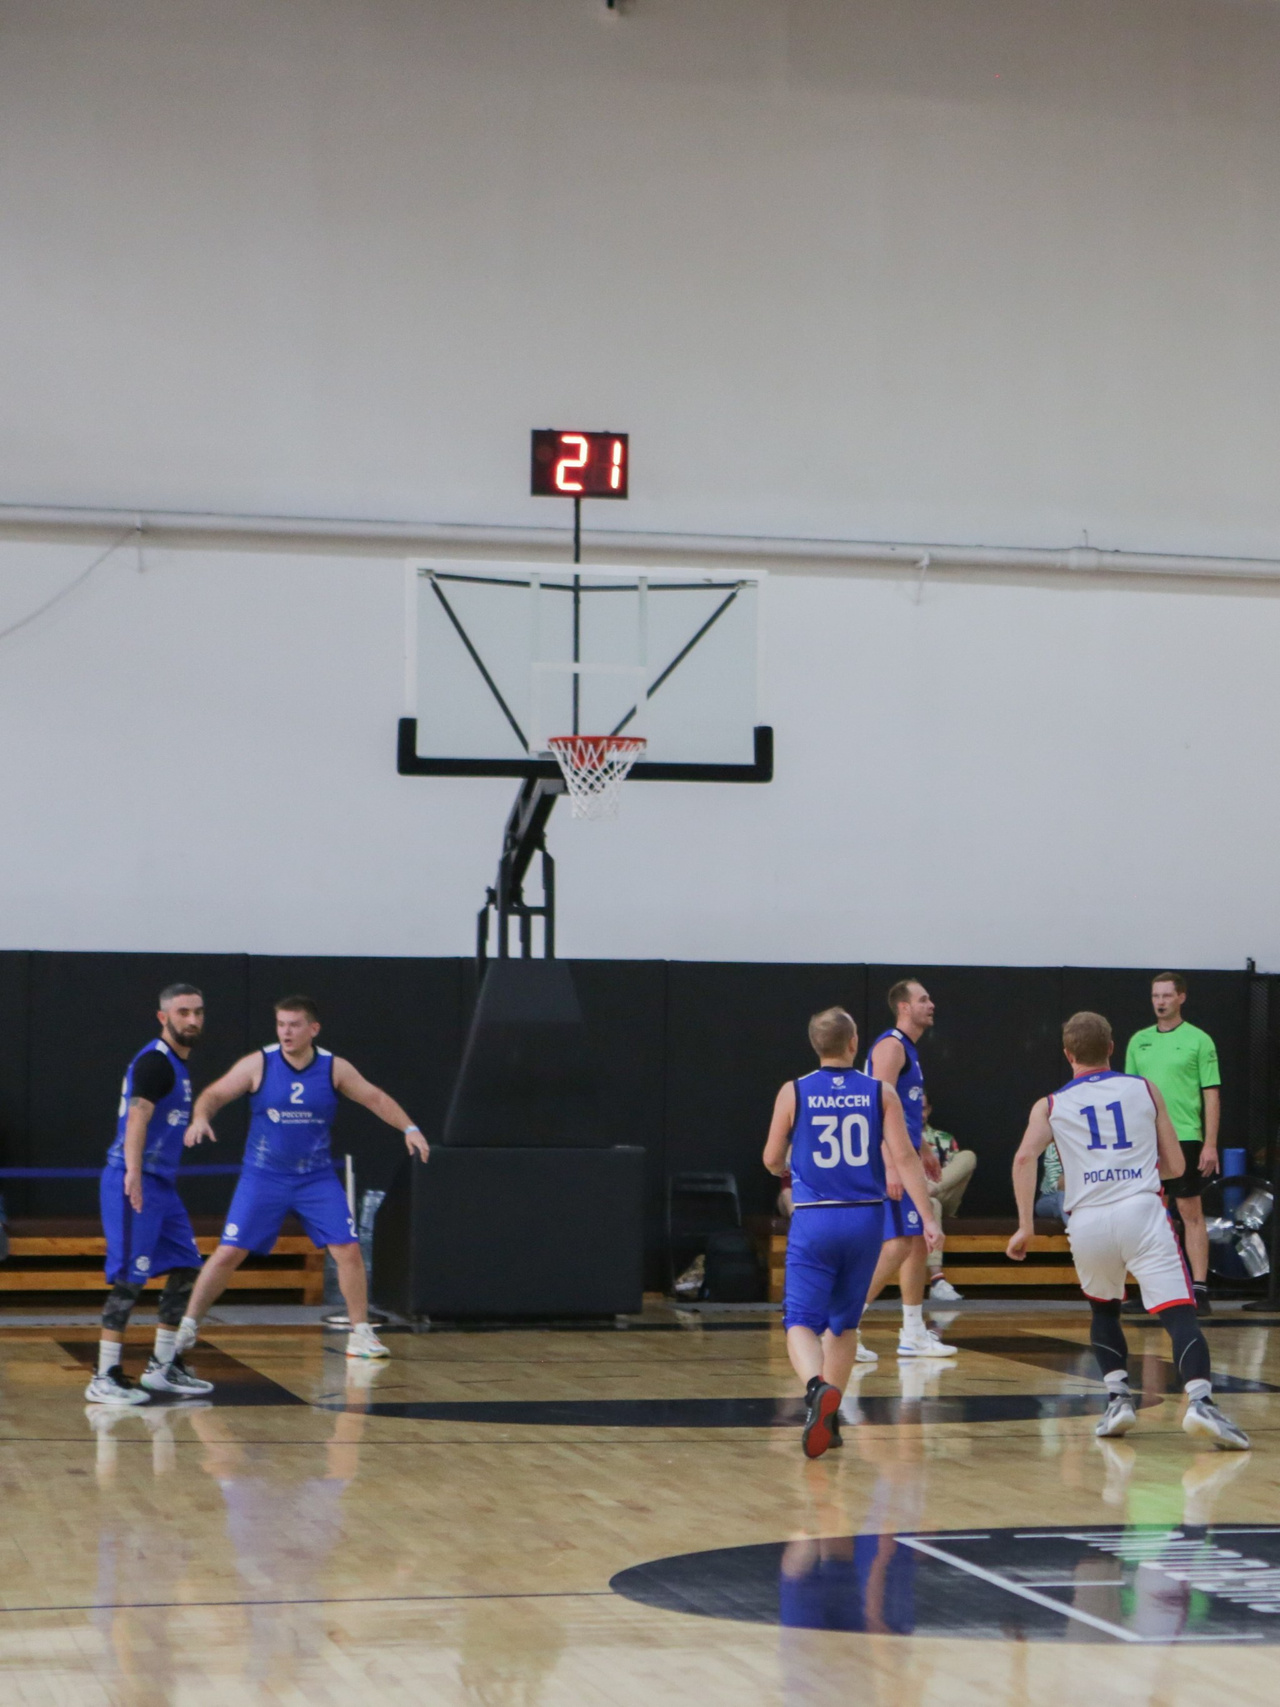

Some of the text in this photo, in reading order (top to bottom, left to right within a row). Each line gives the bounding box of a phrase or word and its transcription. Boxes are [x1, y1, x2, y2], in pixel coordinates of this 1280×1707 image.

[555, 435, 622, 491] 21
[290, 1082, 304, 1104] 2
[808, 1094, 870, 1109] КЛАССЕН
[812, 1113, 869, 1169] 30
[1079, 1100, 1133, 1150] 11
[1083, 1168, 1143, 1185] РОСАТОМ
